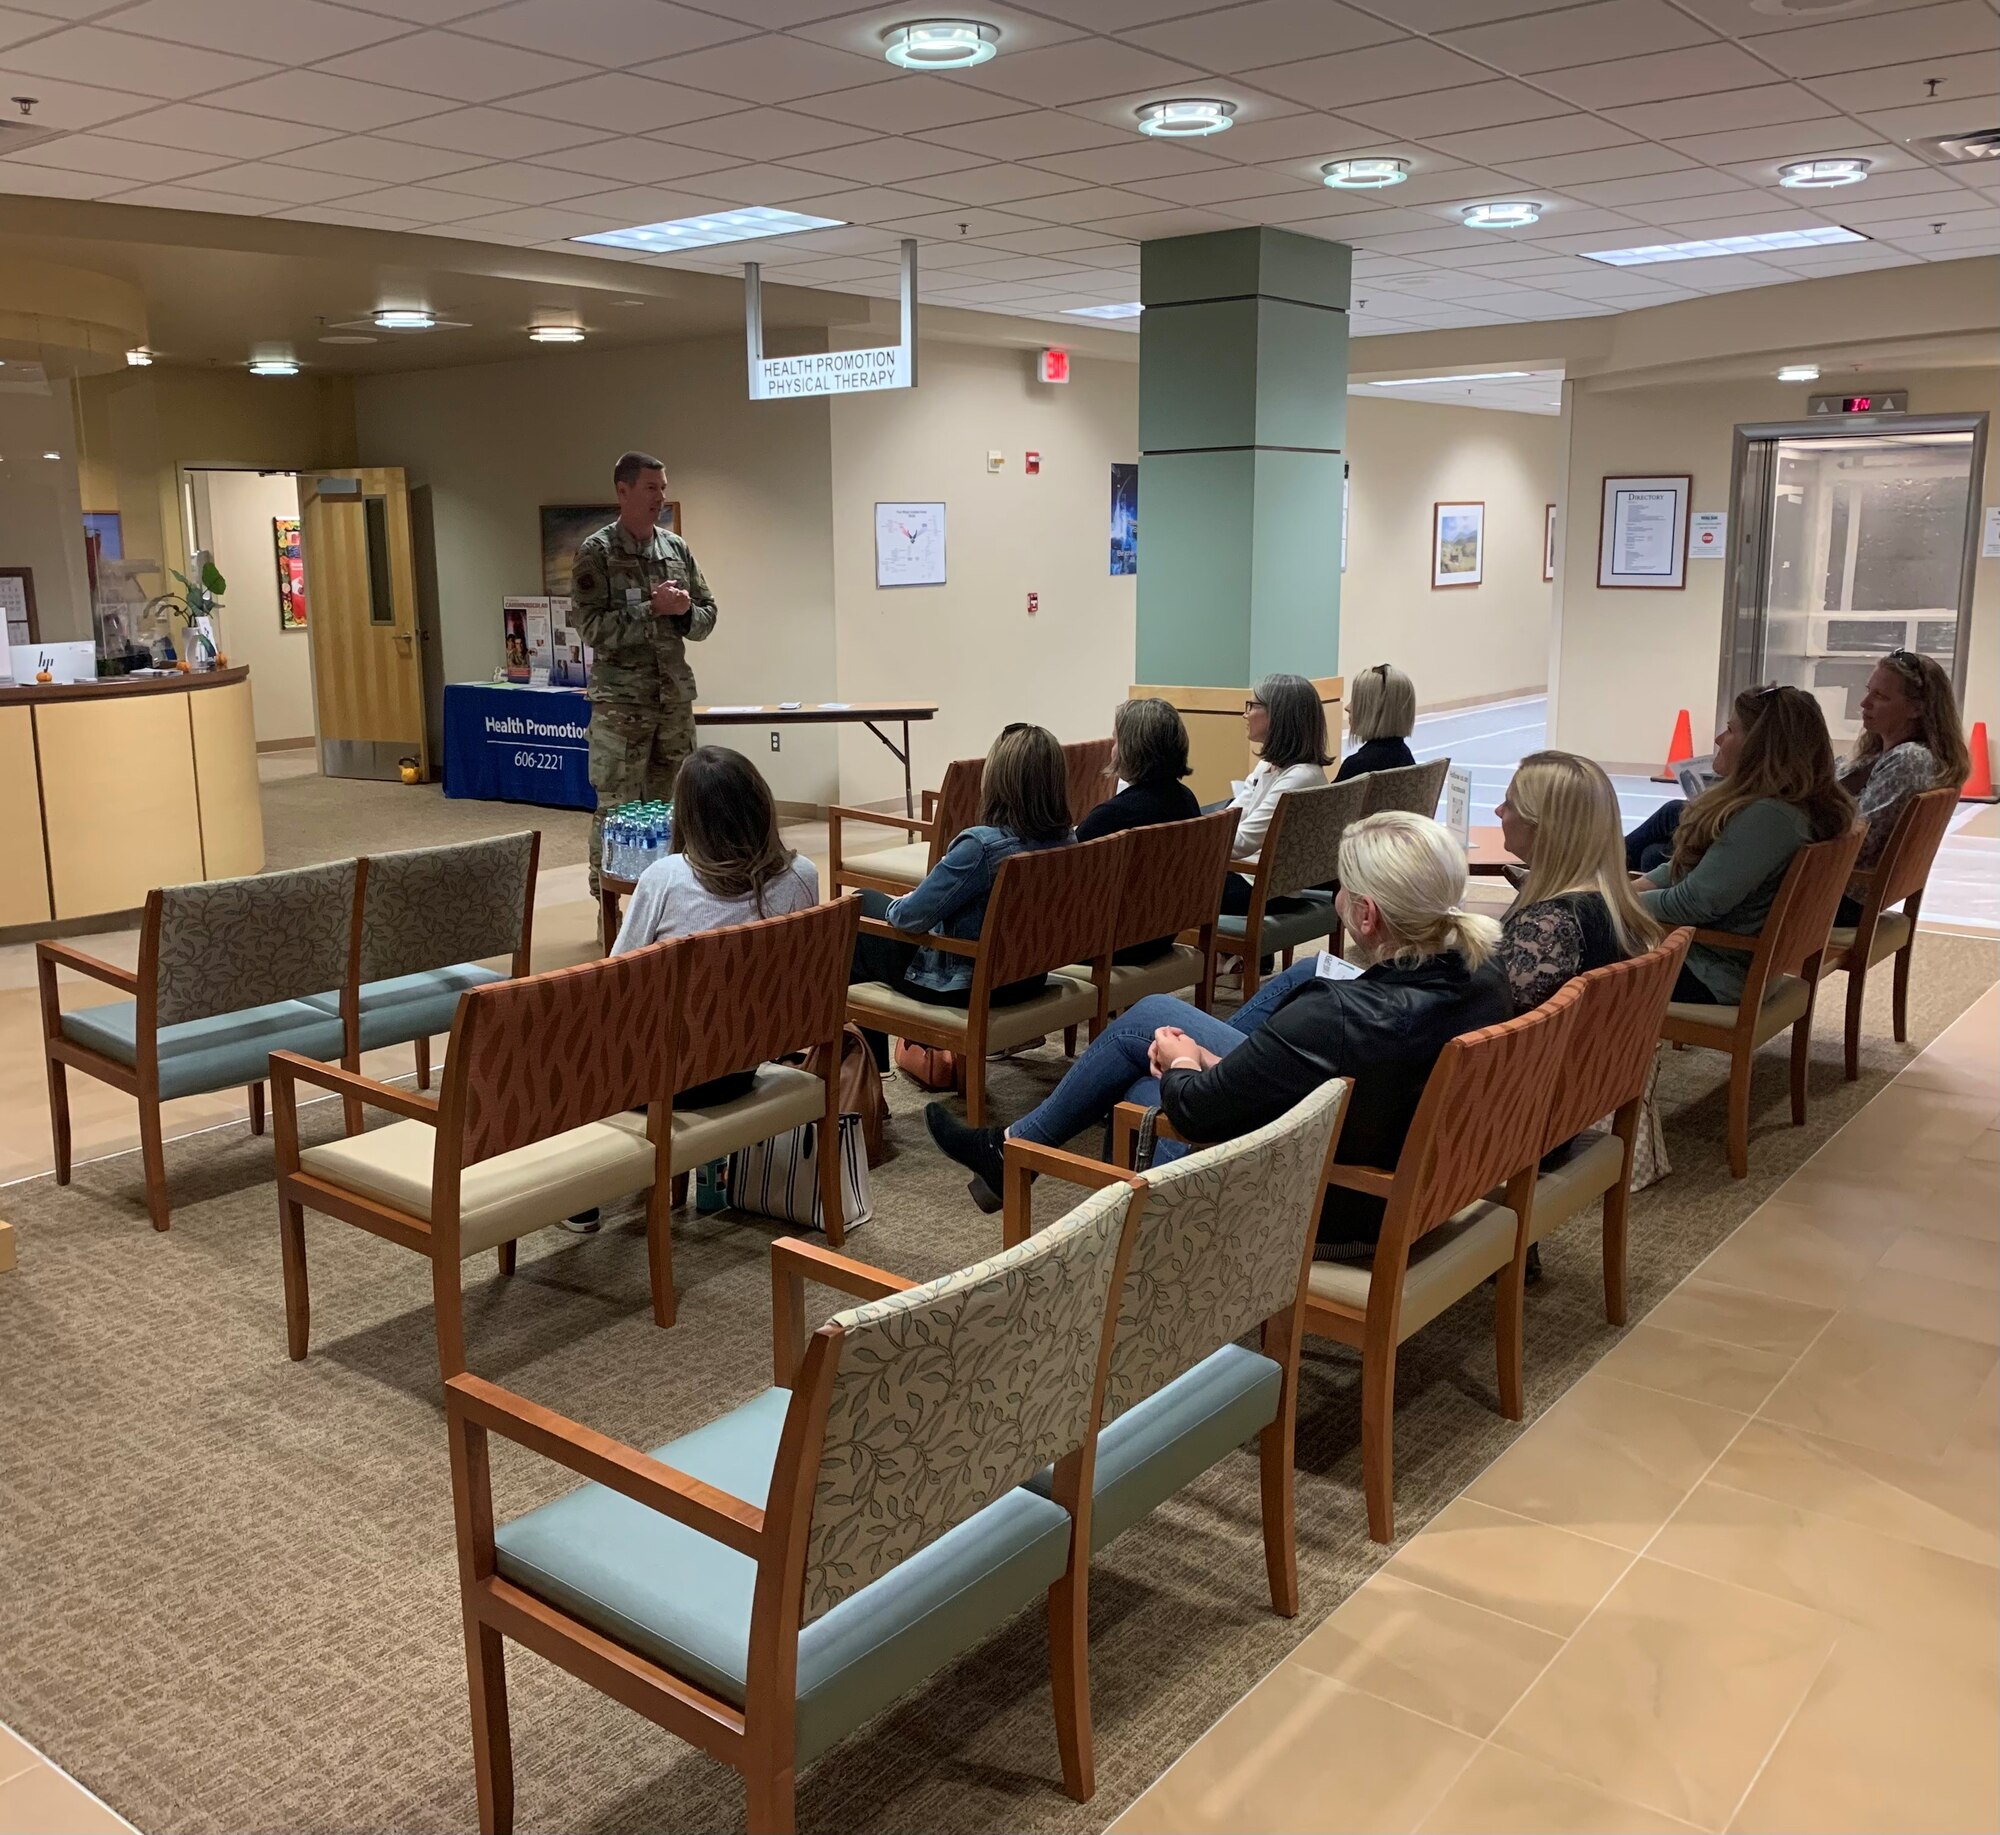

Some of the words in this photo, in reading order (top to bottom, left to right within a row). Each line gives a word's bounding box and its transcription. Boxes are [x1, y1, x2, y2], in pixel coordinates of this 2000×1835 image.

[764, 360, 812, 377] HEALTH
[817, 351, 895, 371] PROMOTION
[768, 377, 830, 395] PHYSICAL
[834, 369, 896, 390] THERAPY
[485, 716, 524, 734] Health
[514, 751, 563, 771] 606-2221
